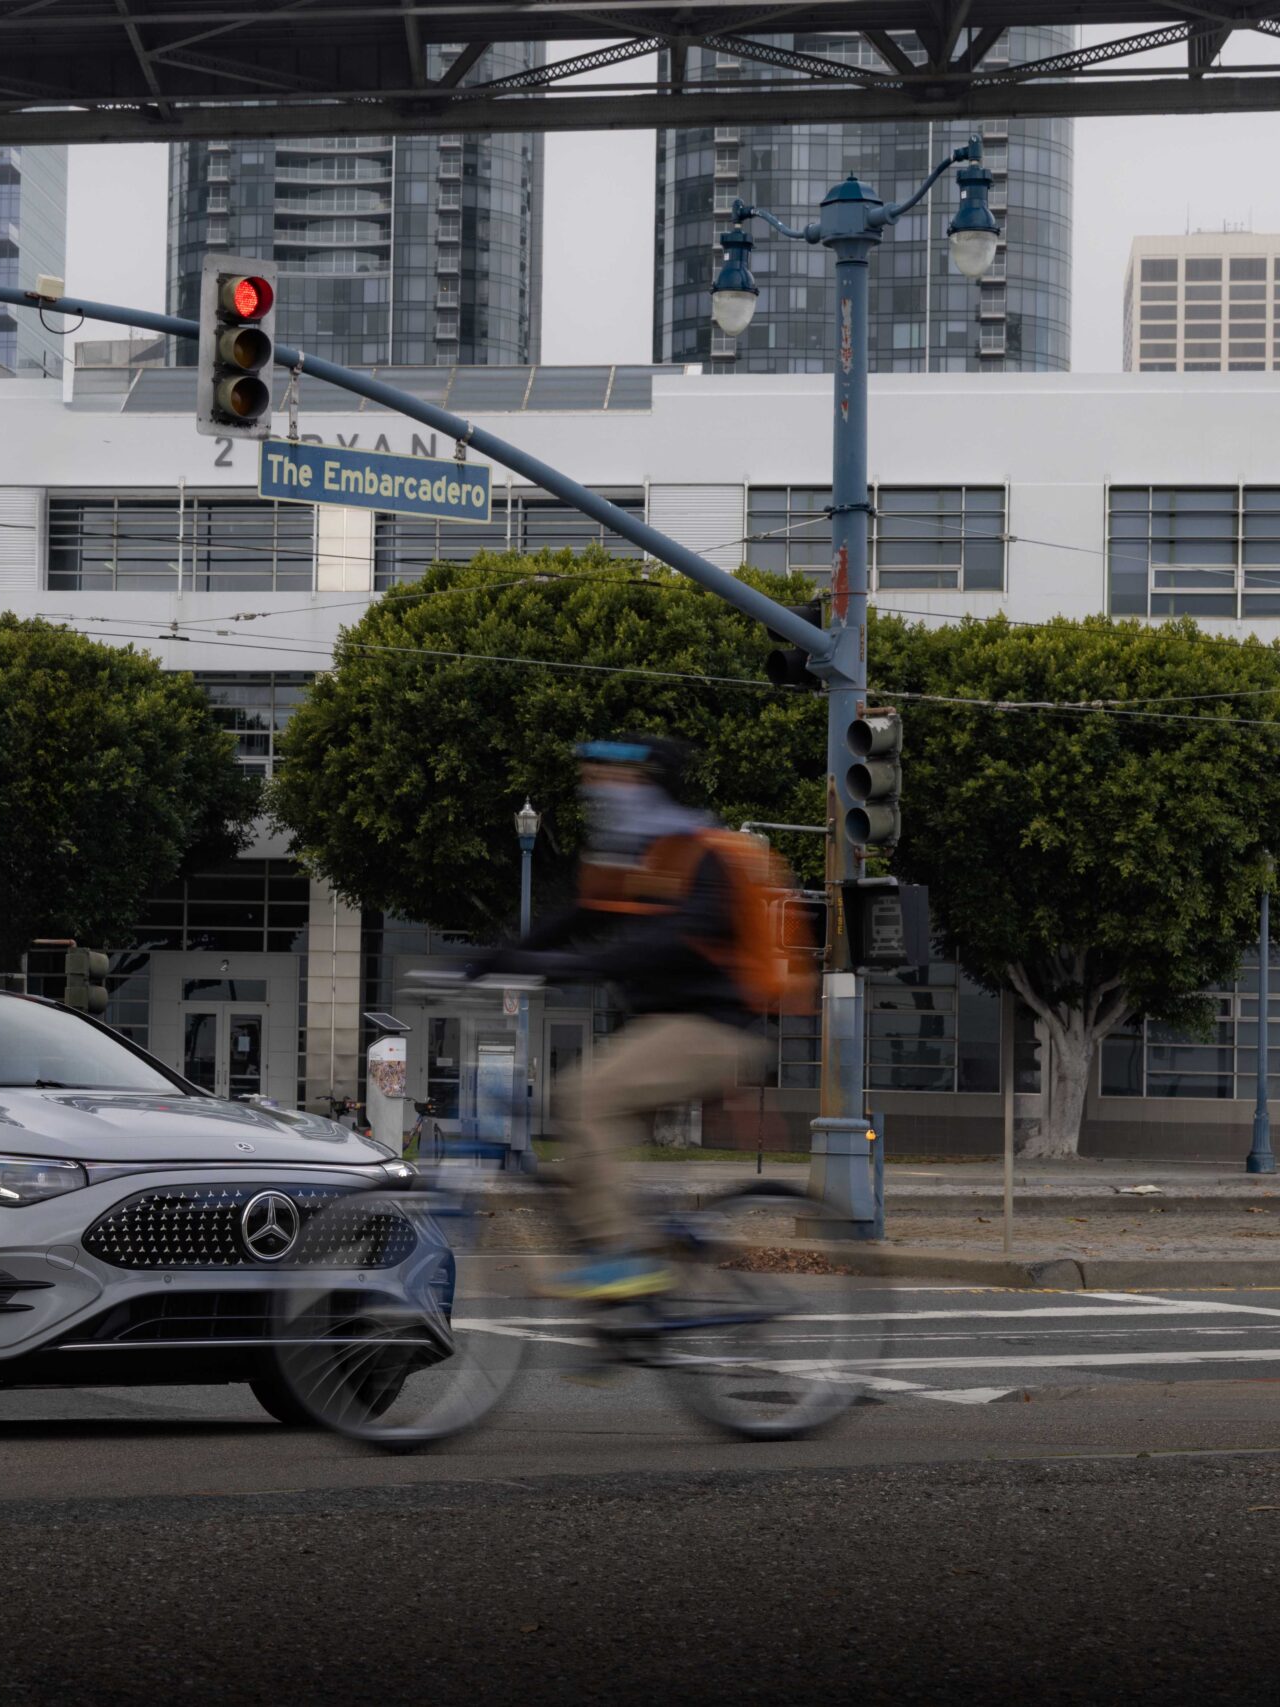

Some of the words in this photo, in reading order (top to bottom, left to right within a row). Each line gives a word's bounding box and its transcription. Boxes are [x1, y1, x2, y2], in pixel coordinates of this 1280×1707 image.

[215, 437, 233, 467] 2
[268, 454, 313, 487] The
[324, 461, 485, 507] Embarcadero
